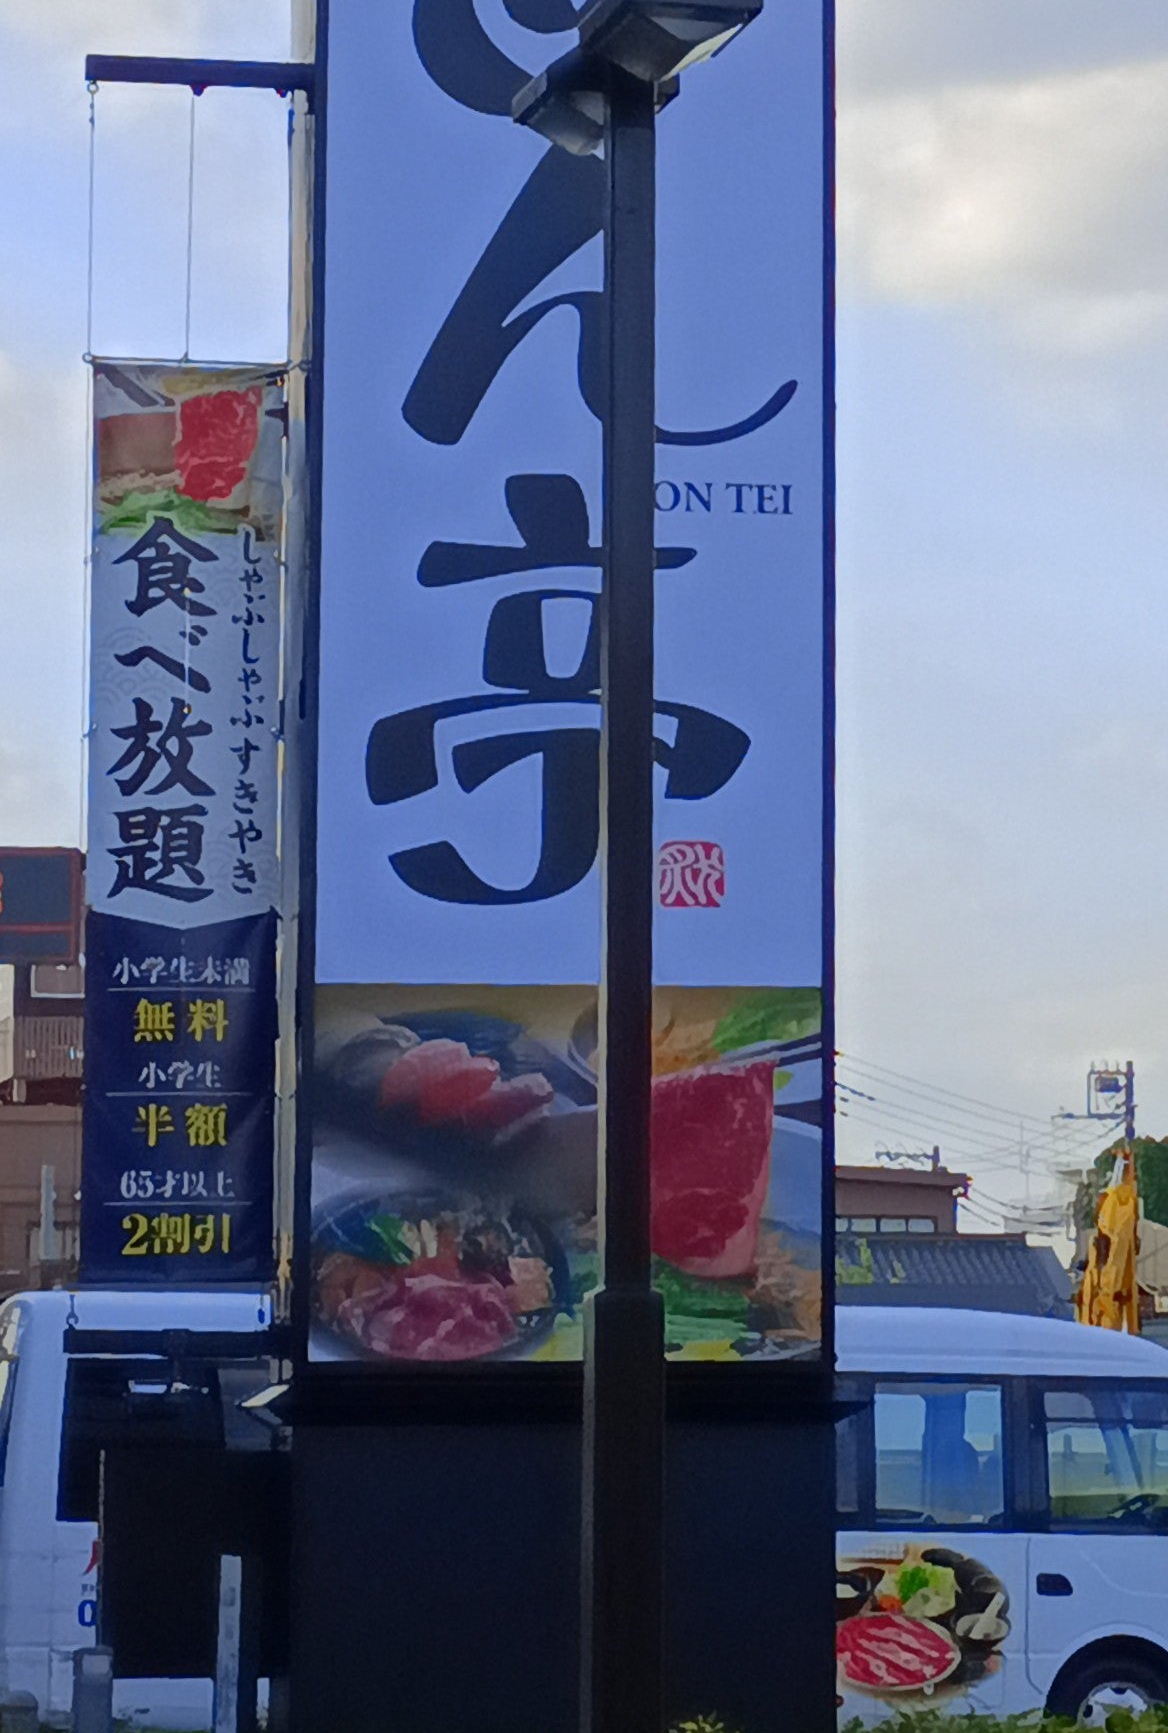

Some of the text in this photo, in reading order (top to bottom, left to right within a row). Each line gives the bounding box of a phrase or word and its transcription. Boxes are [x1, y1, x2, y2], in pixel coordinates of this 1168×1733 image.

[654, 480, 793, 515] ON TEI
[106, 515, 220, 904] 食べ放題
[112, 955, 251, 986] 小学生未満
[133, 997, 229, 1043] 無料
[137, 1060, 222, 1090] 小学生
[131, 1102, 229, 1148] 半額
[120, 1170, 235, 1199] 65才以上
[120, 1211, 232, 1257] 2割引
